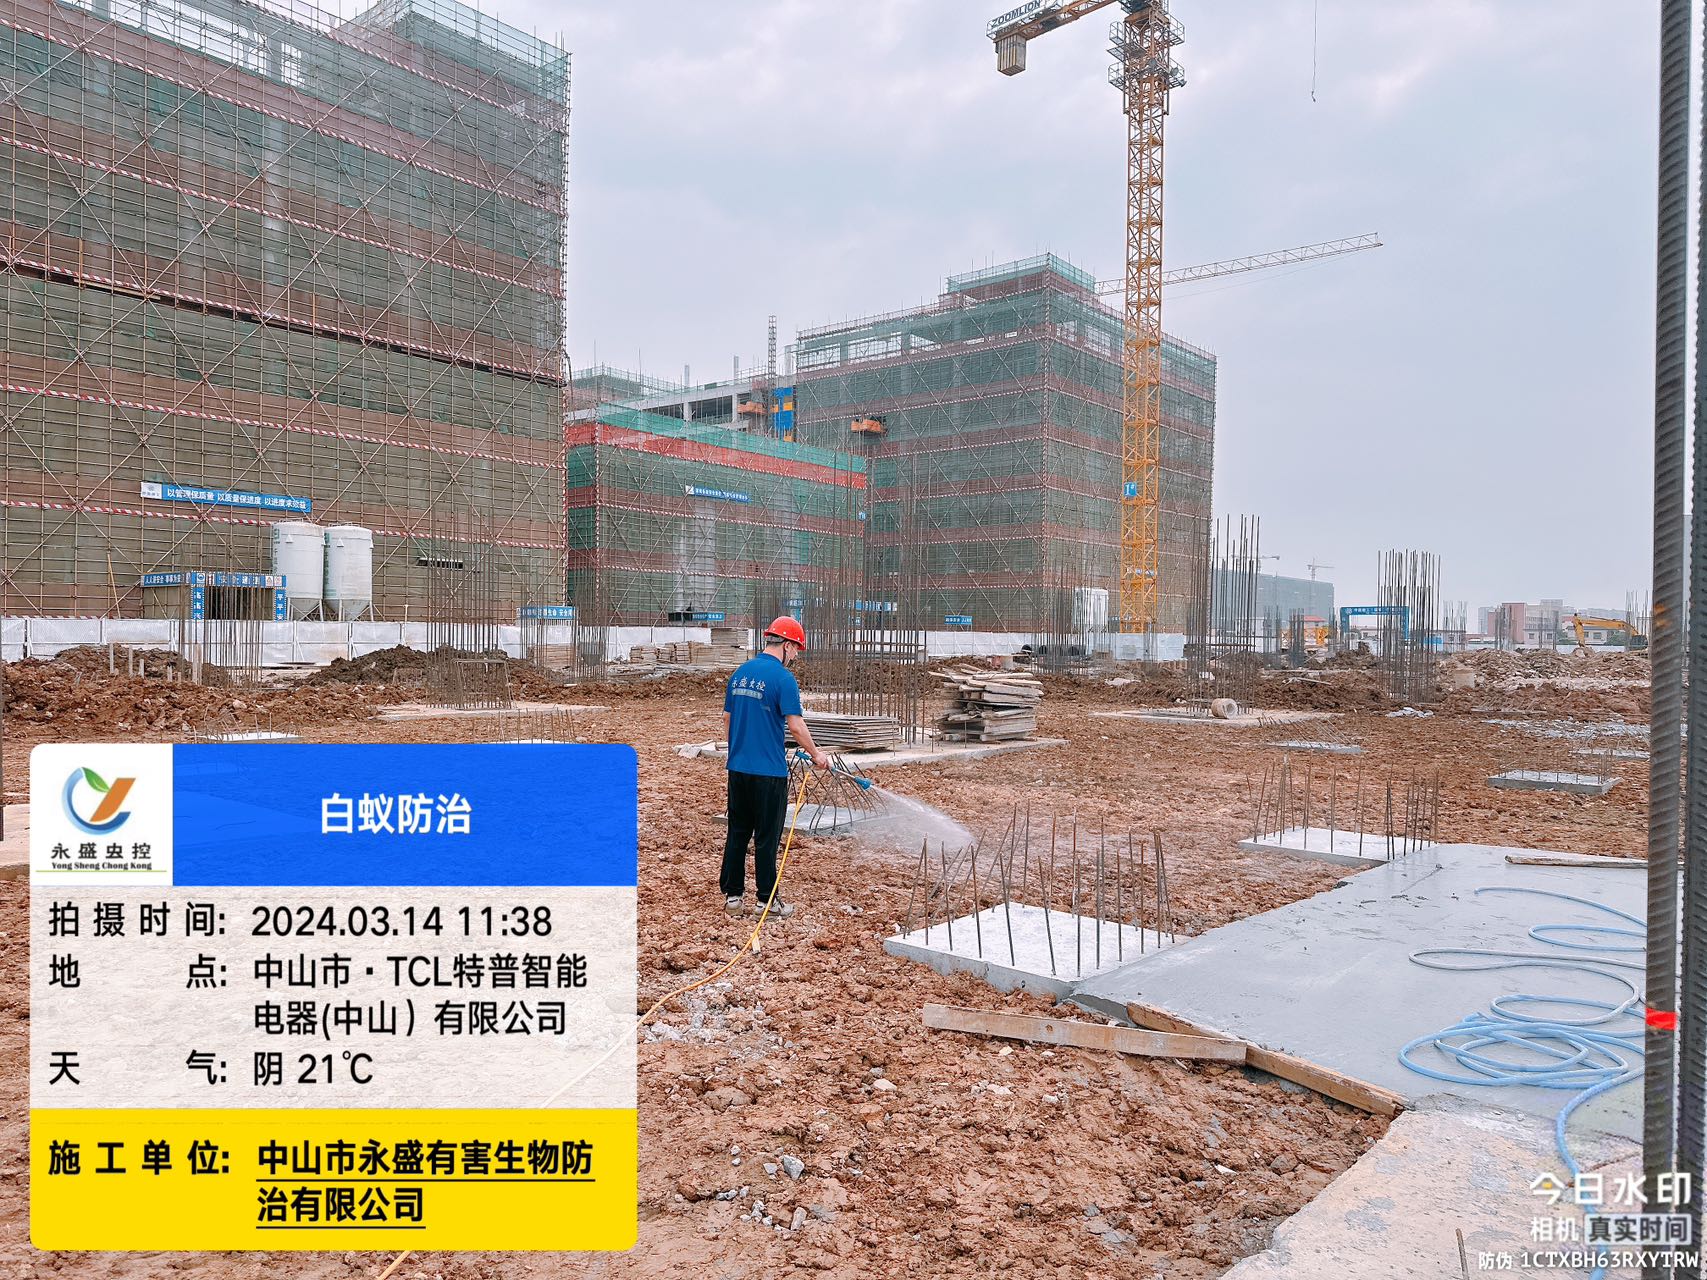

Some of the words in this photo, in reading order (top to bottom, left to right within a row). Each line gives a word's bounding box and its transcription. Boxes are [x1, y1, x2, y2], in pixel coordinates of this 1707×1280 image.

[991, 0, 1041, 28] ZOOMLION
[167, 488, 215, 501] 以管理保质量
[217, 492, 261, 505] 以质量保进度
[264, 496, 307, 509] 以进度求效益
